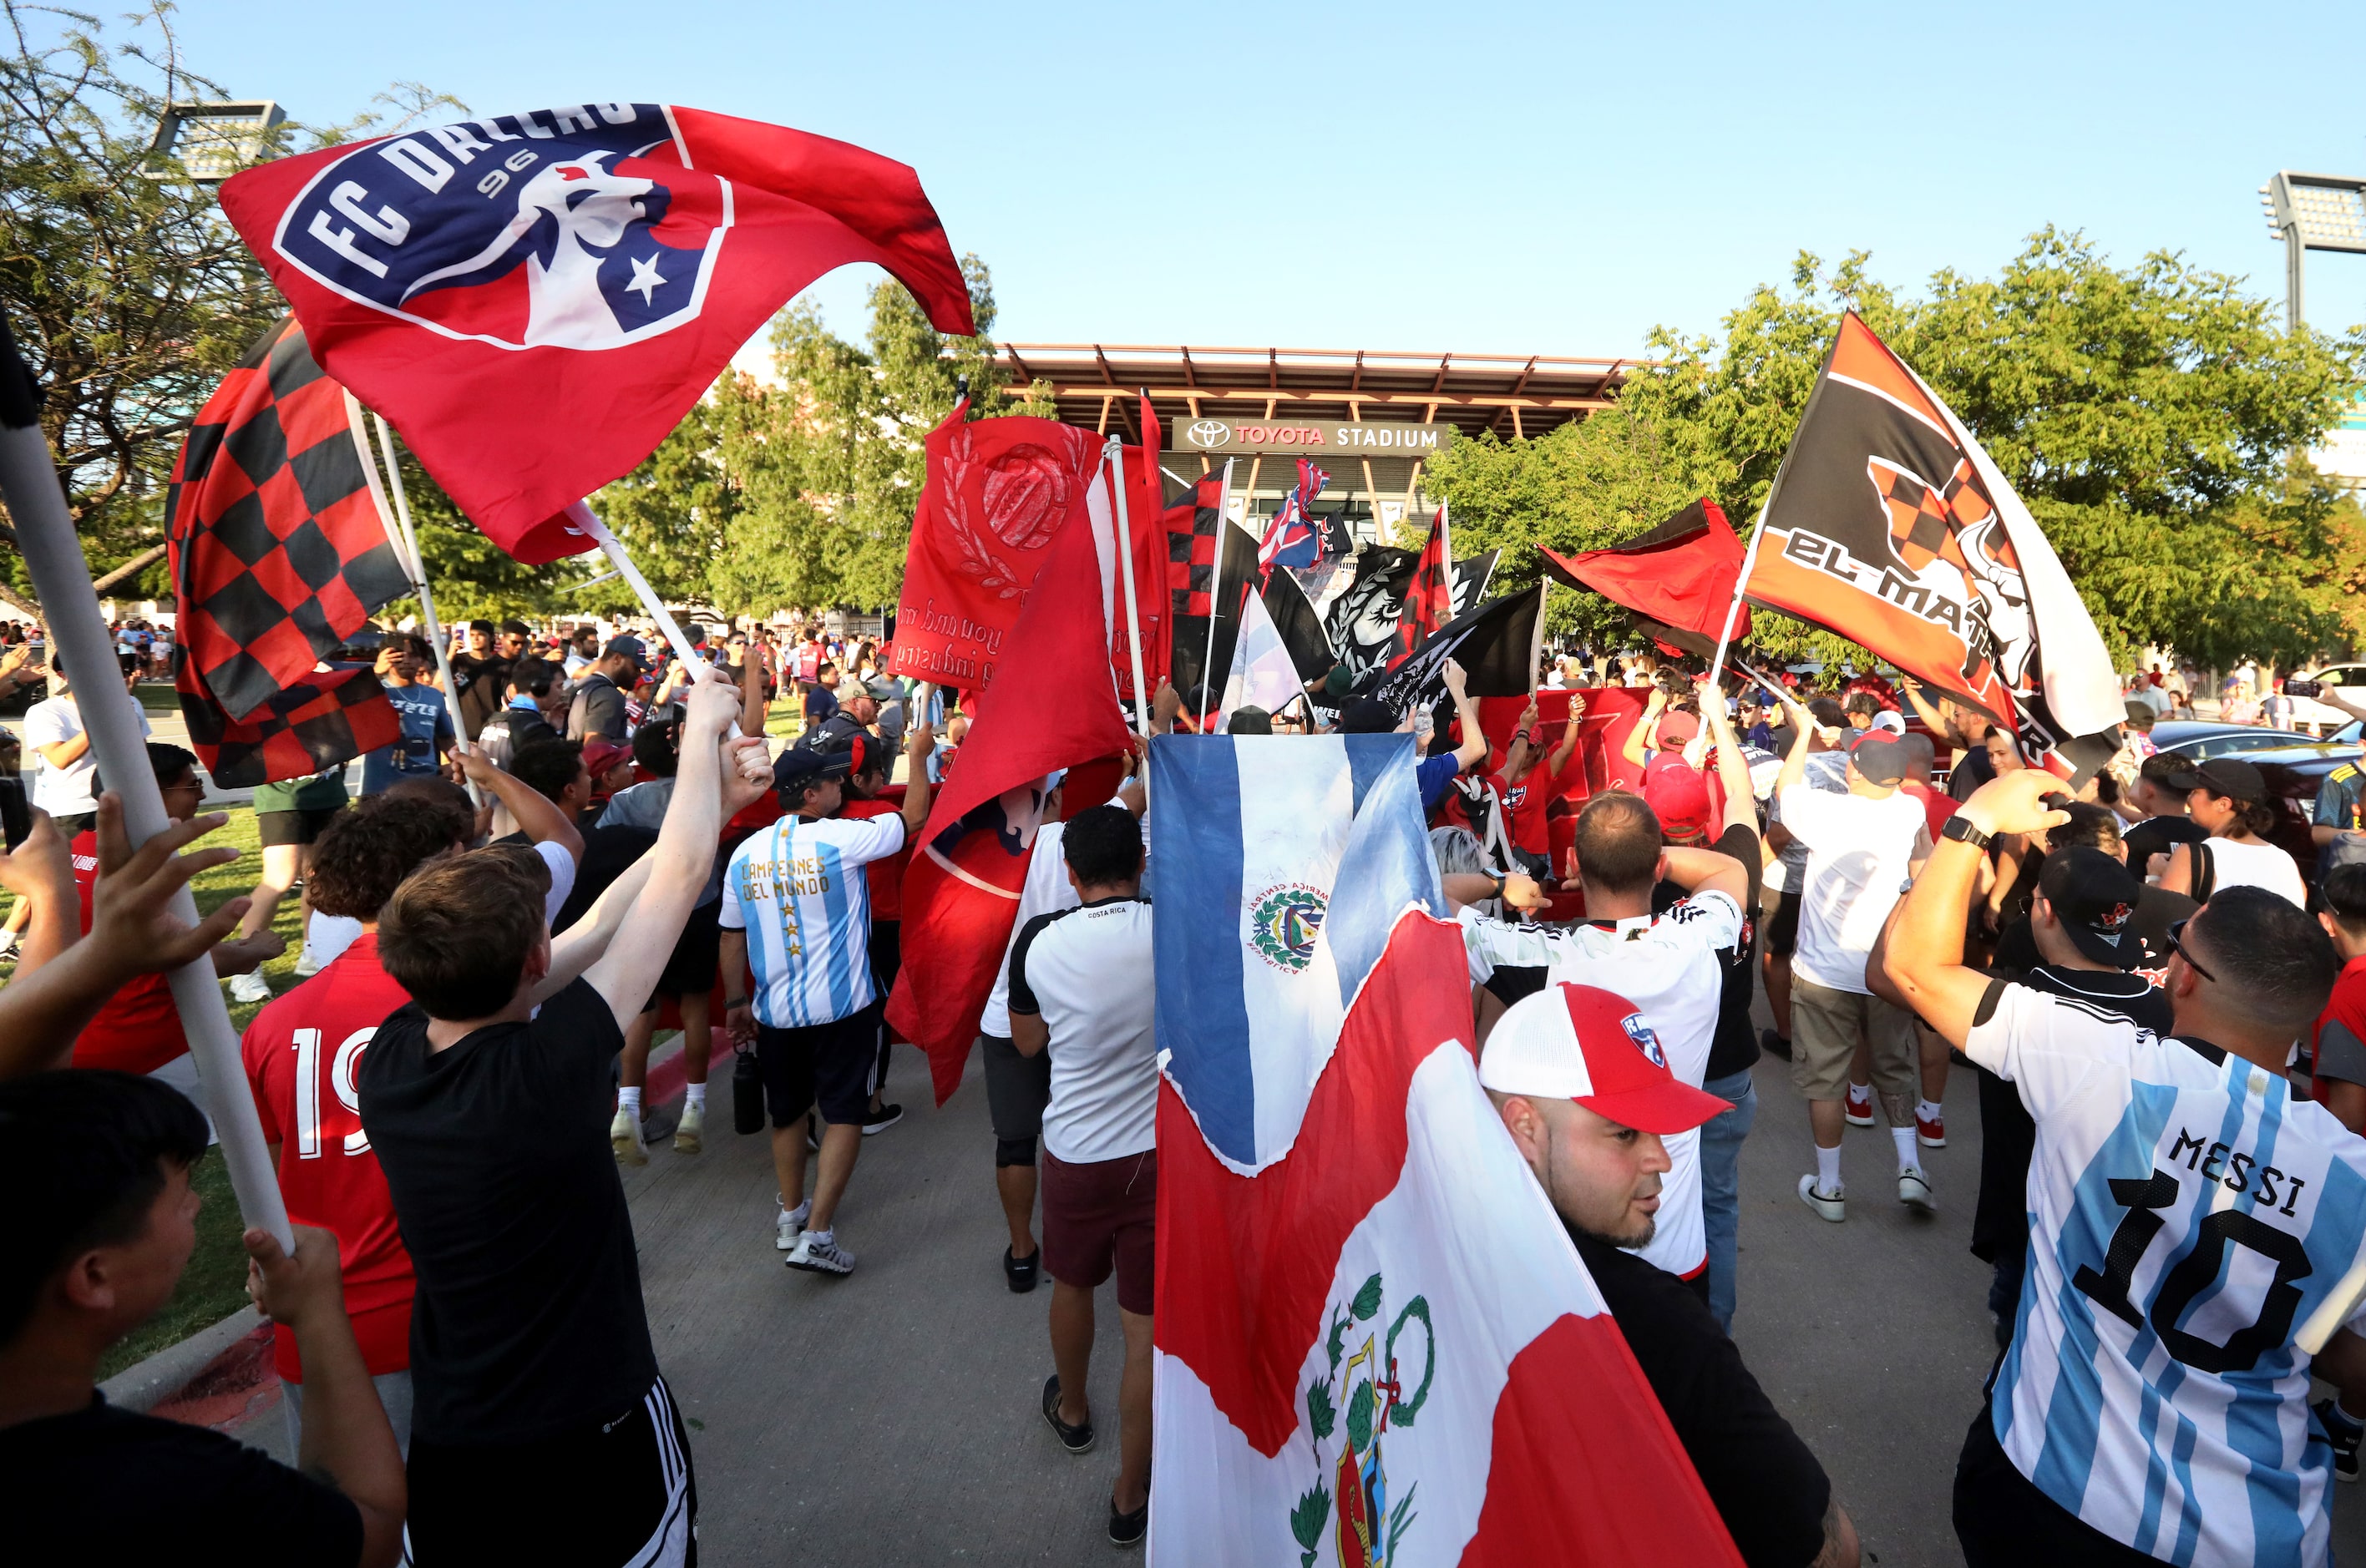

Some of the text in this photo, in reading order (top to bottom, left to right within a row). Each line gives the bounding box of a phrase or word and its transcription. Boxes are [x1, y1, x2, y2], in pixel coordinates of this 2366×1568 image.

[476, 148, 540, 200] 96
[307, 180, 411, 280] FC
[1235, 426, 1438, 448] TOYOTA STADIUM
[742, 856, 826, 881] CAMPEONES
[742, 876, 830, 902] DEL MUNDO
[1087, 907, 1127, 918] COSTA RICA
[291, 1026, 379, 1160] 19
[2169, 1127, 2305, 1219] MESSI
[2073, 1168, 2313, 1374] 10
